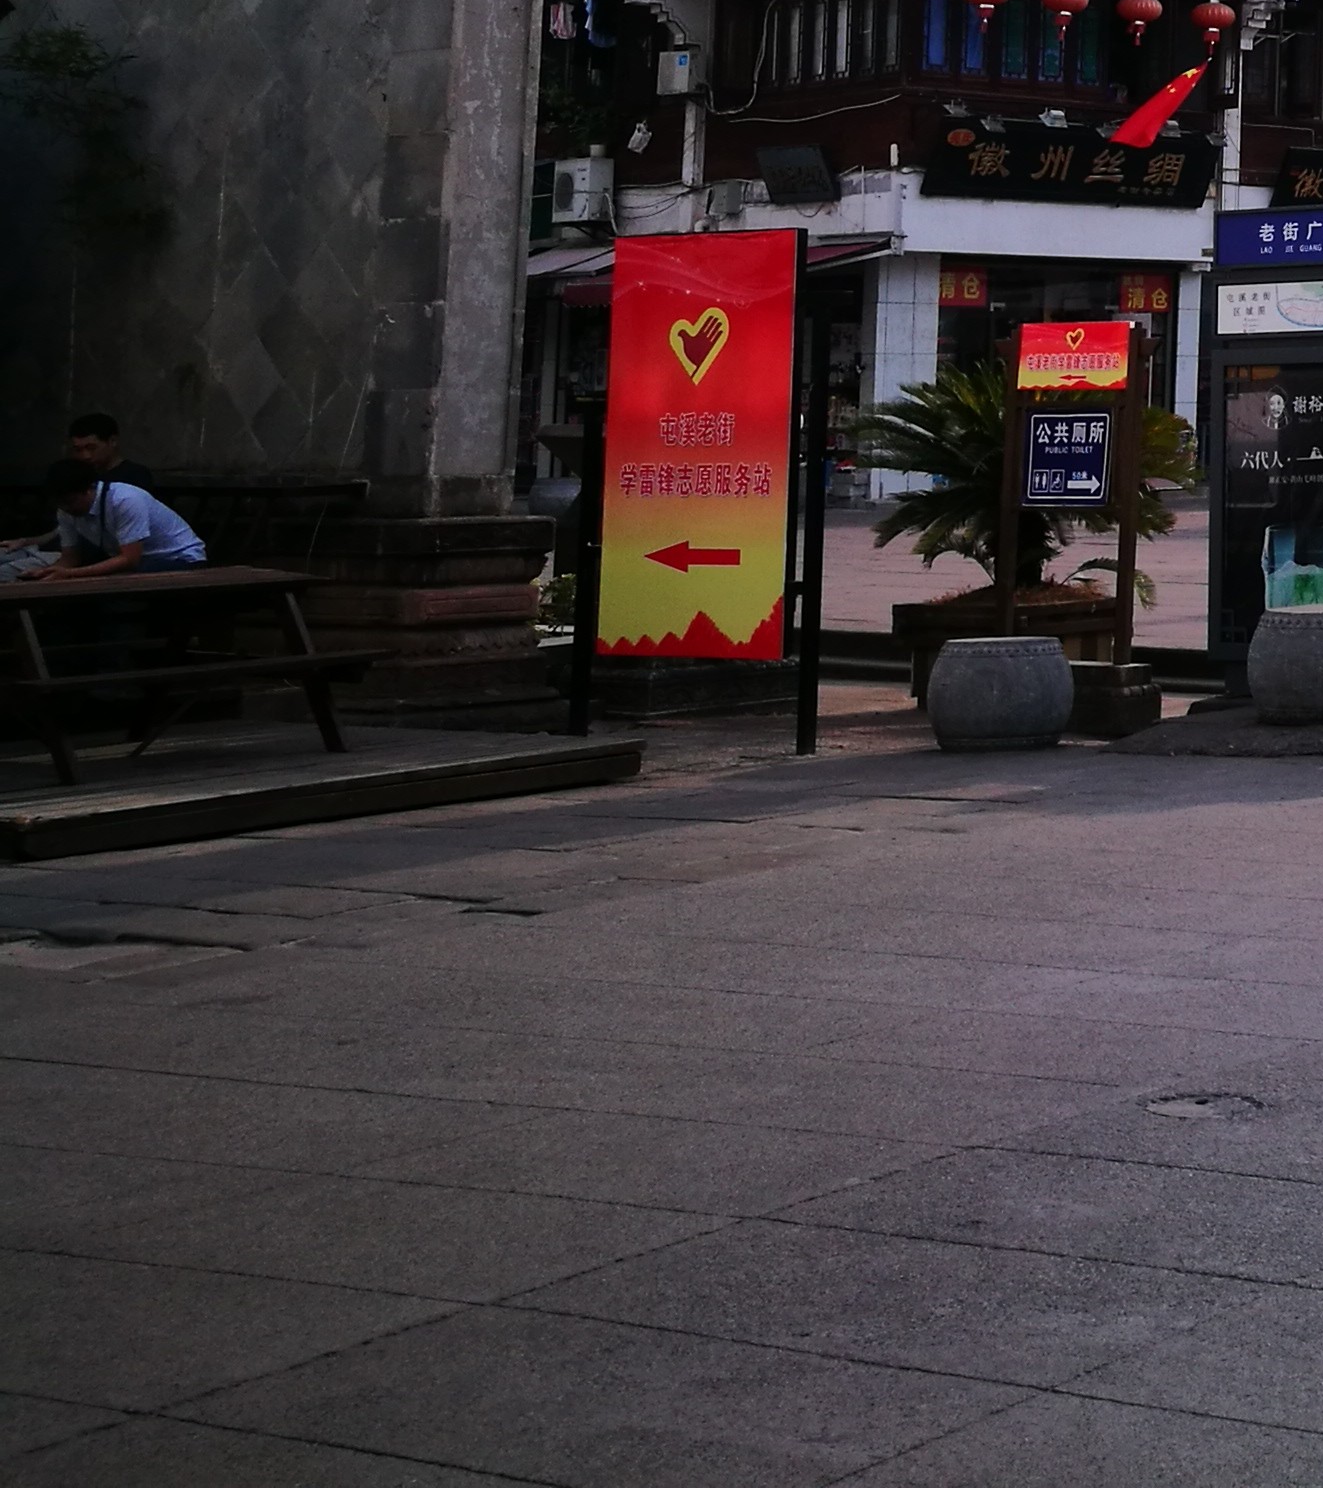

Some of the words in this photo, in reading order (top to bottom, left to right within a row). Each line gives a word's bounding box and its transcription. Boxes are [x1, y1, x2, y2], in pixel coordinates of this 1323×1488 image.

[967, 141, 1186, 187] 徽州丝绸
[1260, 246, 1273, 255] LAO
[1127, 287, 1168, 309] 清仓
[659, 412, 736, 447] 屯溪老街
[1036, 421, 1105, 445] 公共厕所
[1044, 446, 1069, 454] PUBLIC
[1071, 445, 1094, 454] TOILET
[620, 462, 773, 497] 学雷锋志愿服务站
